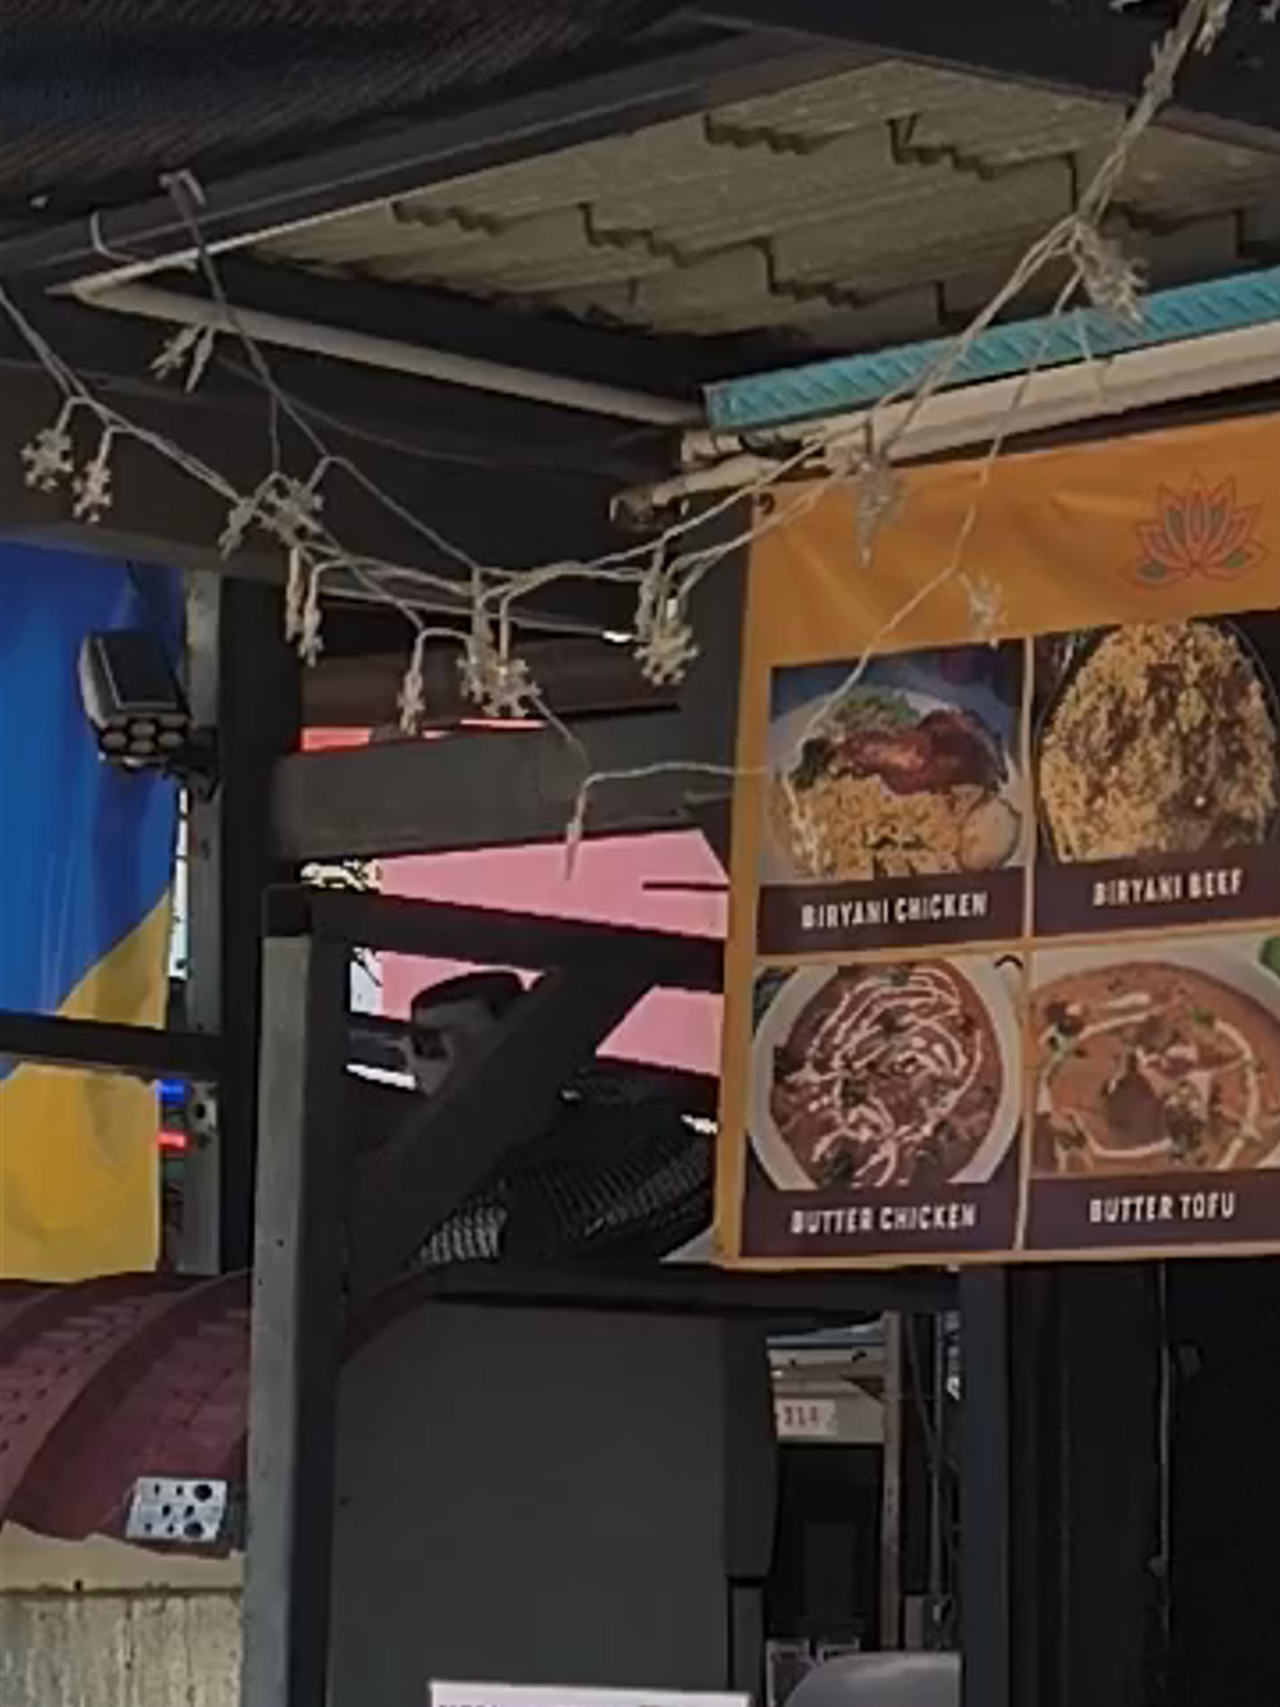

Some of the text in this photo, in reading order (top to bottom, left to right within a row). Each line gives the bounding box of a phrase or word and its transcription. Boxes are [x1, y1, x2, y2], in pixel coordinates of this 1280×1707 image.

[1093, 869, 1242, 907] BIRYANI BEEF
[801, 891, 988, 930] BIRYANI CHICKEN
[791, 1204, 976, 1235] BUTTER CHICKEN
[1089, 1191, 1235, 1223] BUTTER TOFU
